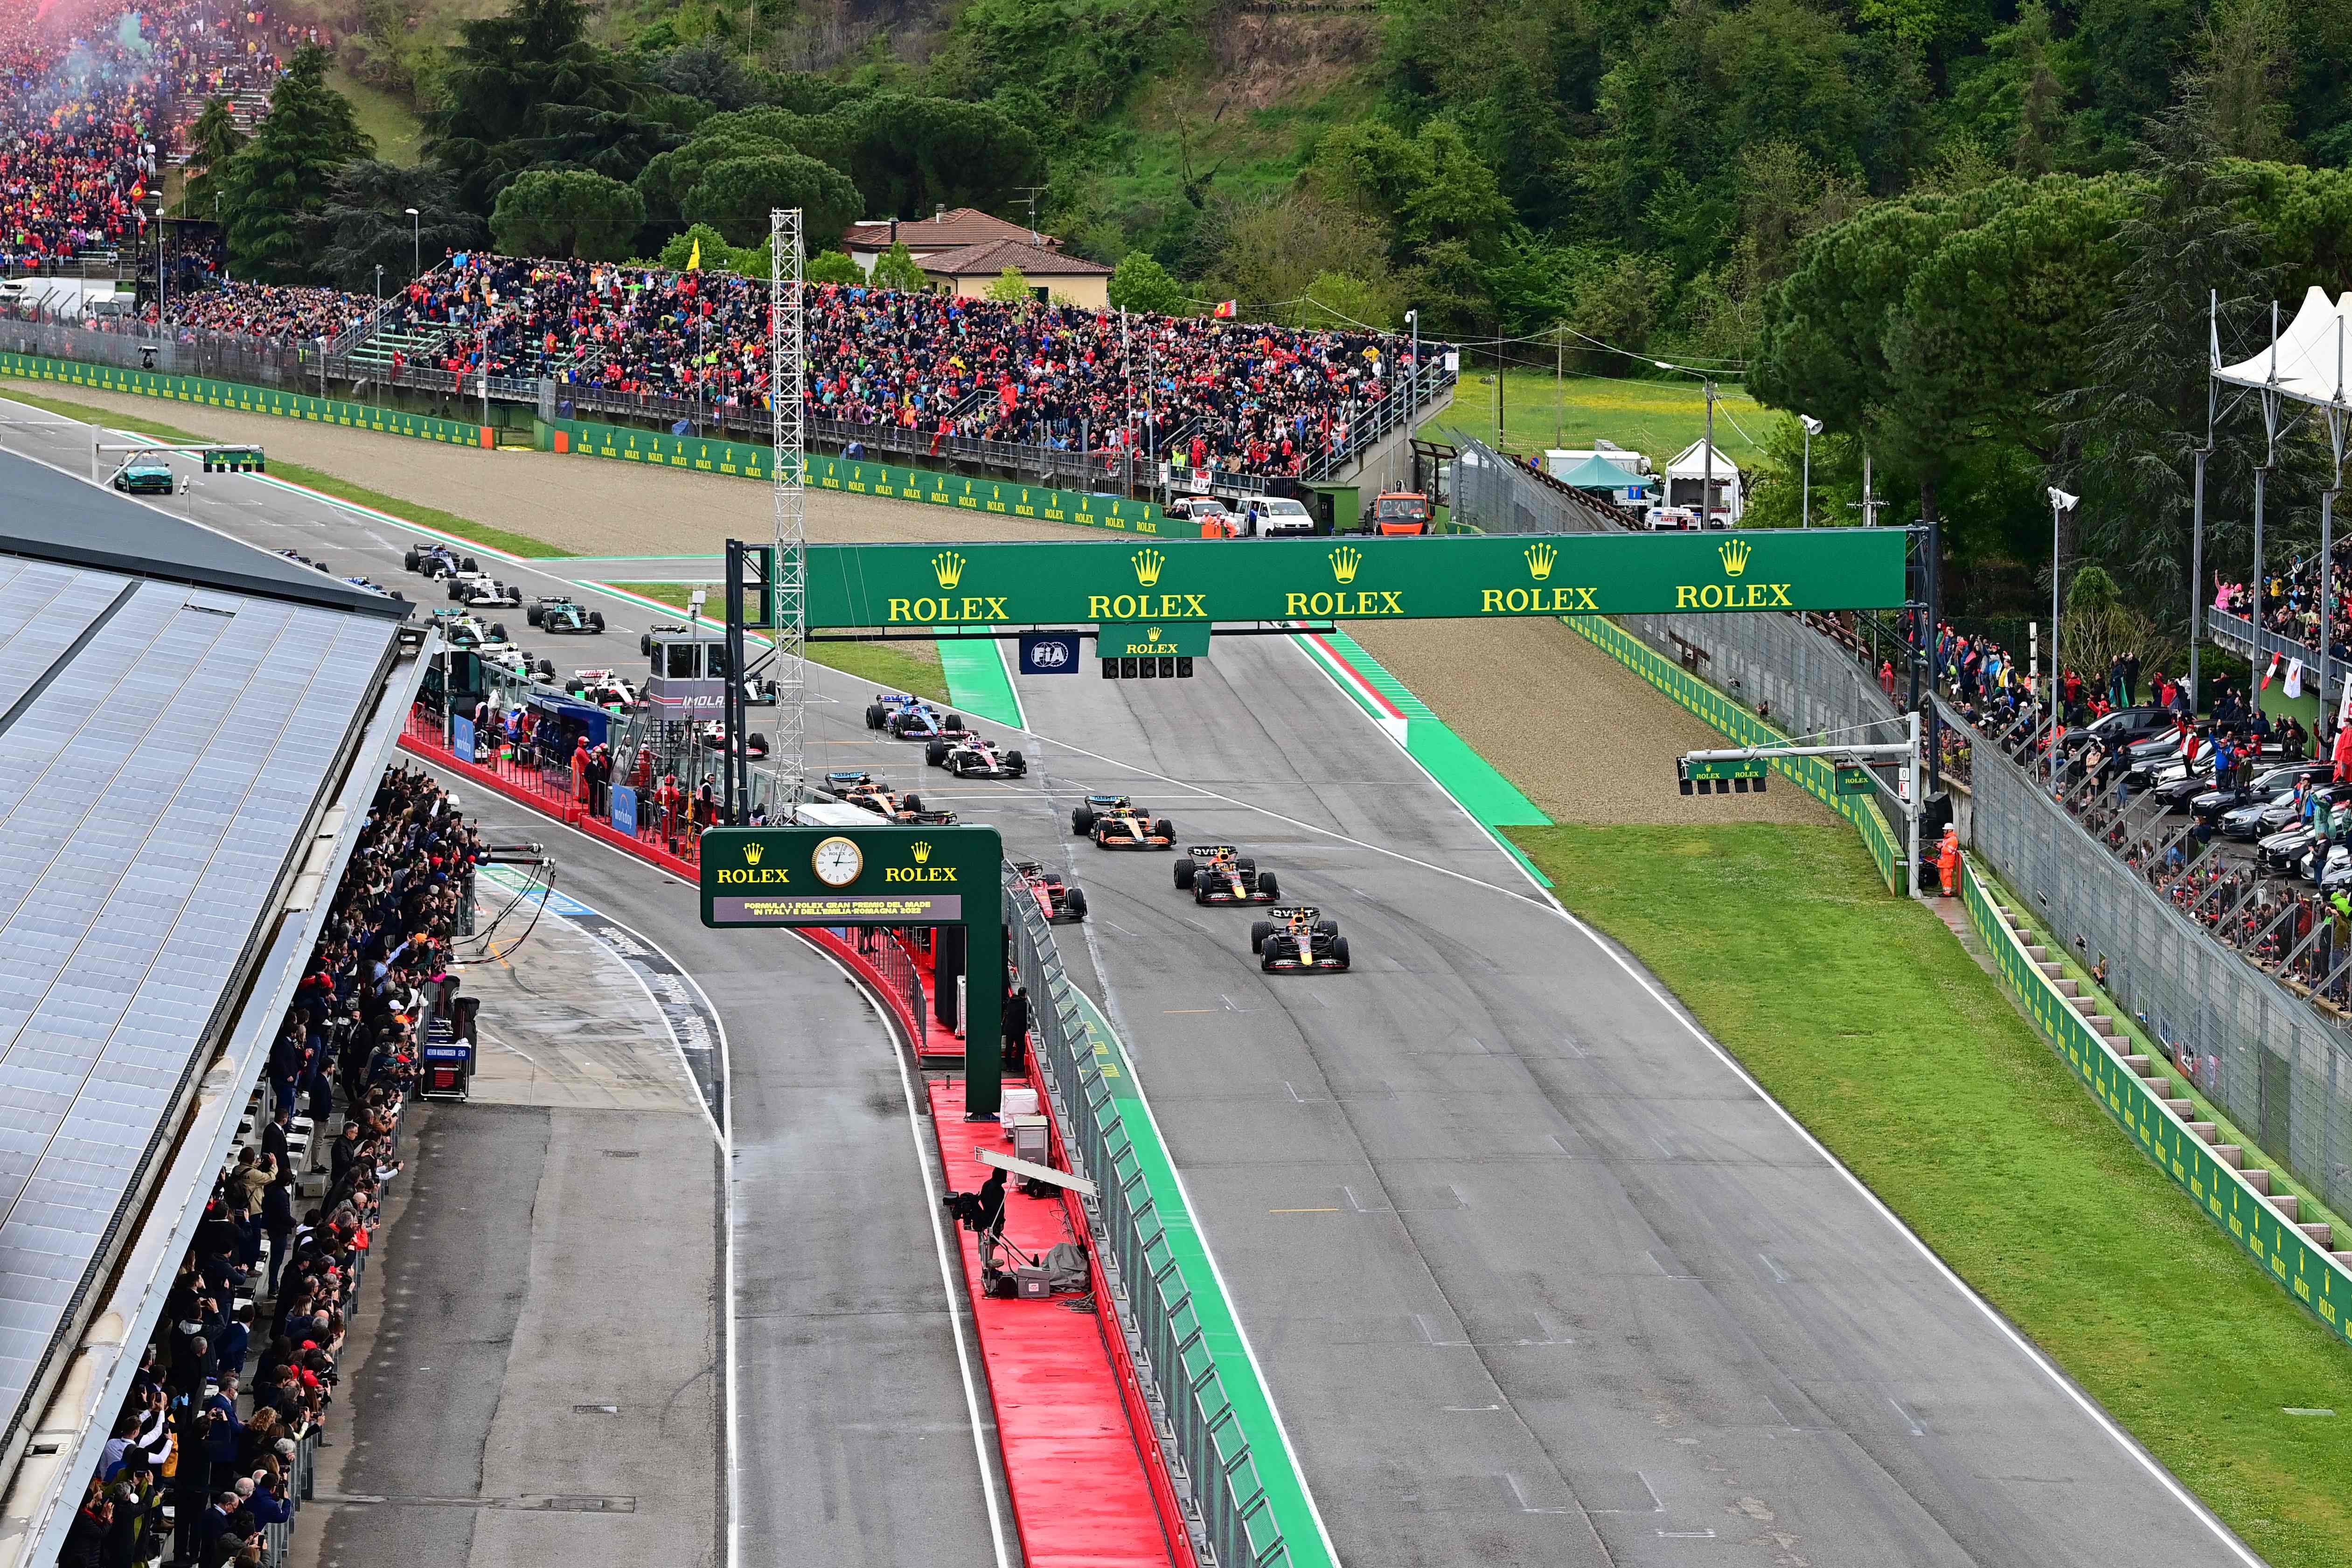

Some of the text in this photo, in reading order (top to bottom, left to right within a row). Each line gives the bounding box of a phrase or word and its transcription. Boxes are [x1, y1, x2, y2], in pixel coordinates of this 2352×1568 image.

[578, 443, 592, 453] ROLEX
[601, 446, 616, 457] ROLEX
[624, 449, 640, 460] ROLEX
[648, 452, 663, 462] ROLEX
[671, 456, 687, 466] ROLEX
[696, 459, 711, 470] ROLEX
[721, 463, 736, 474] ROLEX
[746, 466, 761, 477] ROLEX
[822, 477, 839, 488] ROLEX
[848, 481, 865, 492] ROLEX
[875, 485, 892, 495] ROLEX
[903, 488, 921, 499] ROLEX
[931, 492, 948, 503] ROLEX
[959, 496, 977, 508] ROLEX
[987, 501, 1005, 512] ROLEX
[1015, 505, 1034, 516] ROLEX
[1044, 509, 1064, 520] ROLEX
[1075, 513, 1094, 524] ROLEX
[1106, 517, 1125, 529] ROLEX
[1136, 522, 1156, 533] ROLEX
[1482, 588, 1599, 611] ROLEX
[1676, 584, 1792, 608] ROLEX
[1088, 594, 1207, 618] ROLEX
[1286, 591, 1403, 615] ROLEX
[888, 597, 1009, 621] ROLEX
[1127, 644, 1177, 654] ROLEX
[457, 737, 471, 756] workday
[1902, 770, 1907, 778] 0
[615, 808, 632, 829] workday
[717, 867, 958, 883] ROLEX ROLEX
[2156, 1140, 2166, 1165] ROLEX
[2173, 1159, 2184, 1182] ROLEX
[2191, 1175, 2203, 1199] ROLEX
[2210, 1193, 2222, 1219] ROLEX
[2229, 1212, 2242, 1239] ROLEX
[2250, 1233, 2263, 1260] ROLEX
[2272, 1253, 2286, 1282] ROLEX
[2295, 1275, 2310, 1303] ROLEX
[2319, 1295, 2335, 1324] ROLEX
